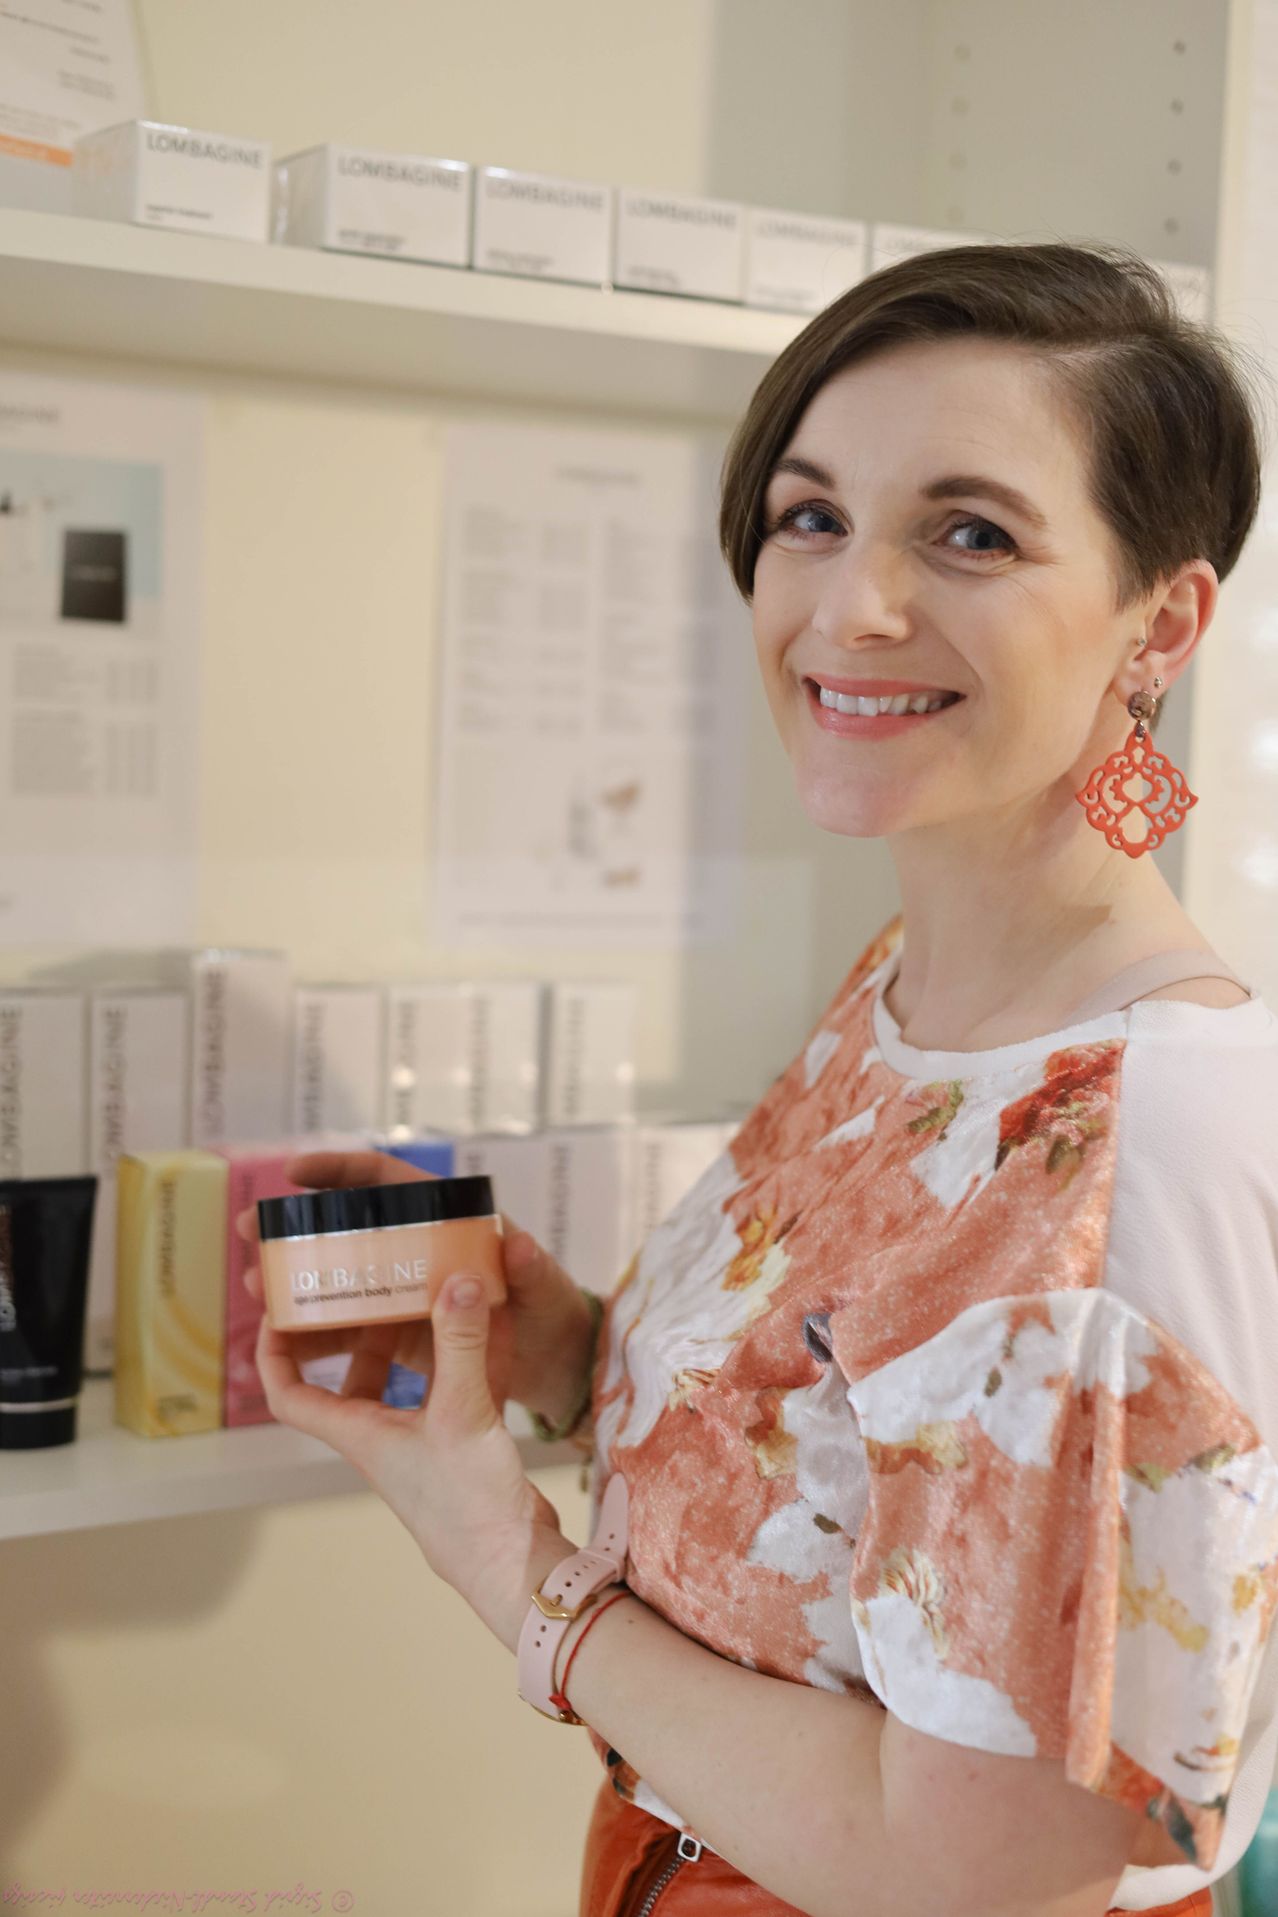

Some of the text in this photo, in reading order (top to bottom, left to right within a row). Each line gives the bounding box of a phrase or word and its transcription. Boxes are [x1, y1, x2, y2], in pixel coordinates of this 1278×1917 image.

[146, 131, 263, 171] LOMBAGINE
[337, 154, 464, 194] LOMBAGINE
[486, 177, 605, 213] LOMBAGINE
[311, 1289, 362, 1303] prevention
[364, 1285, 392, 1298] body
[394, 1282, 428, 1293] cream
